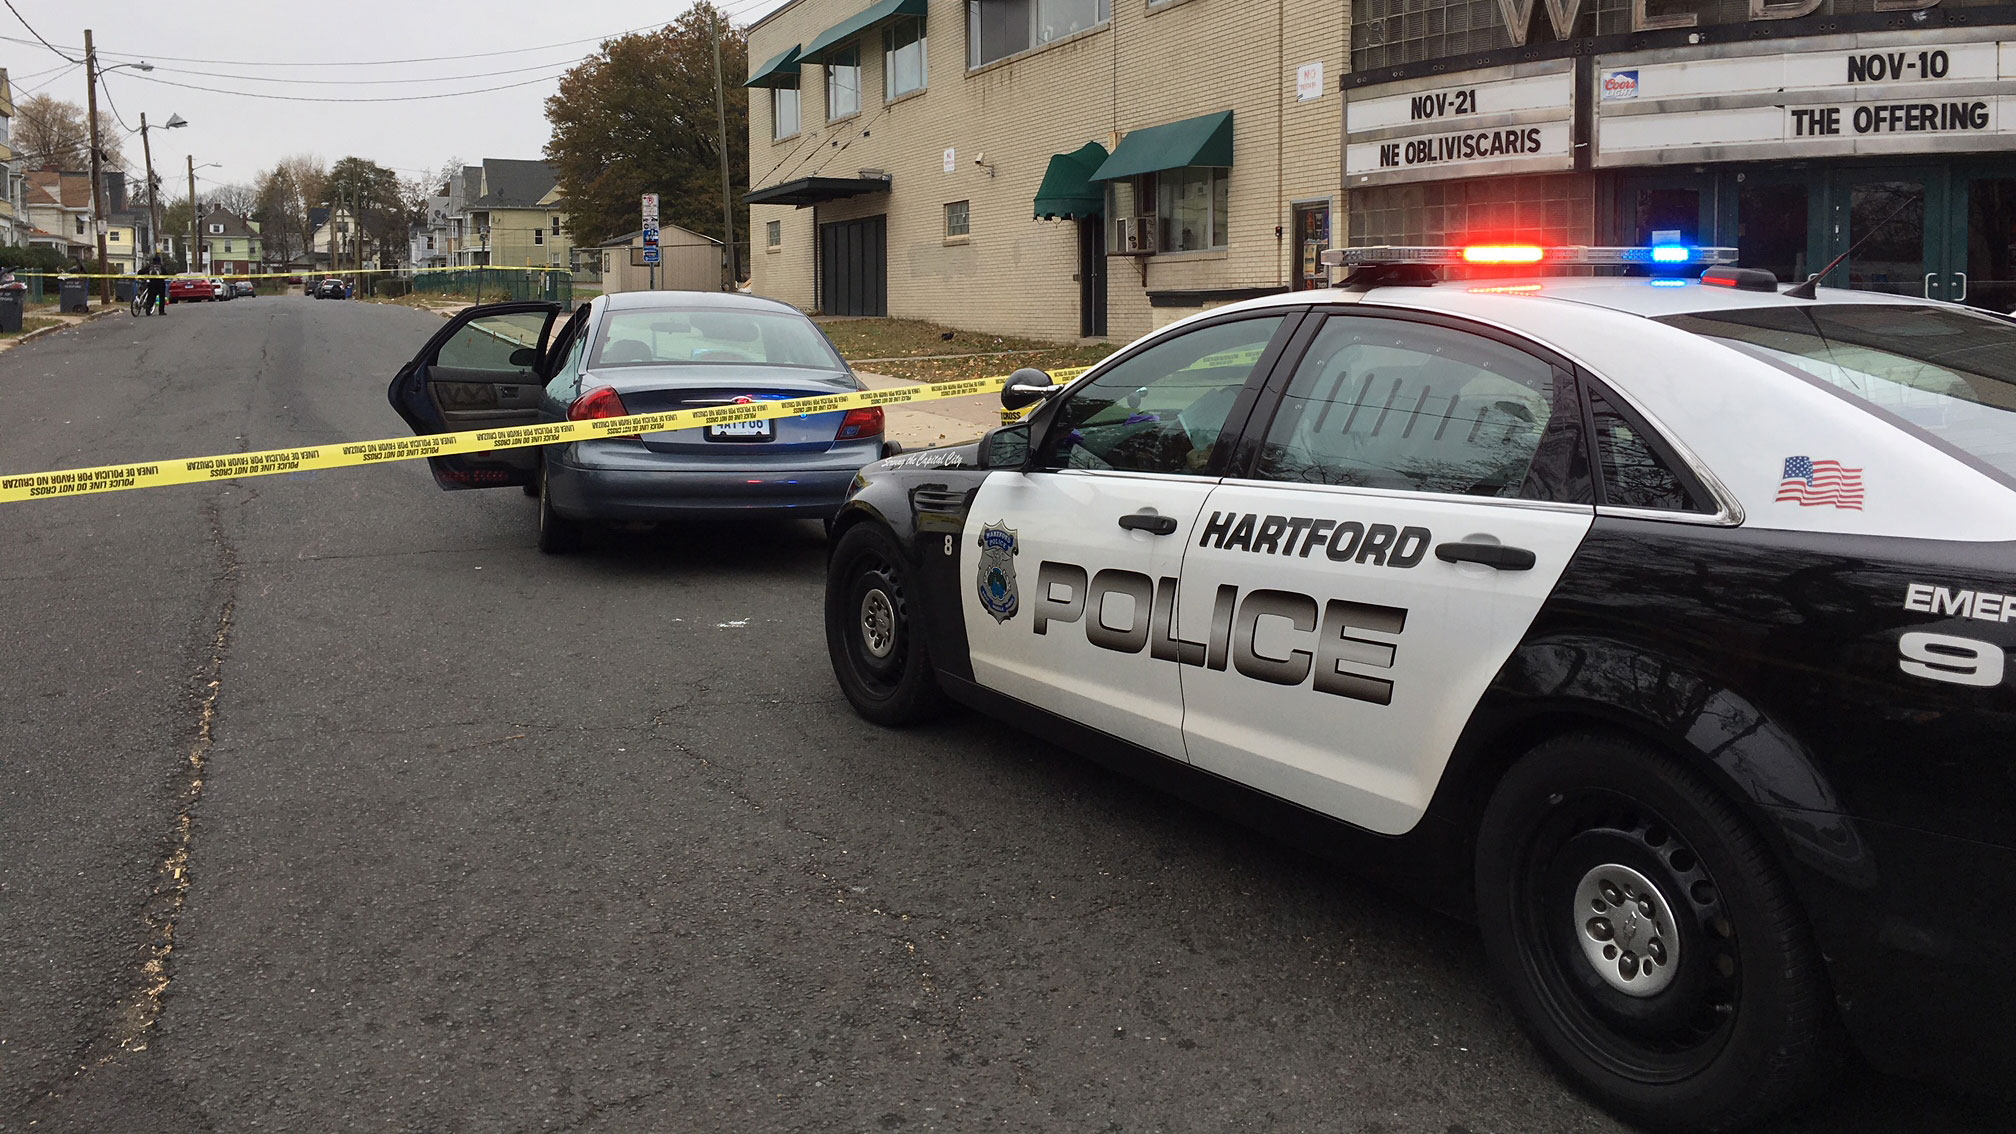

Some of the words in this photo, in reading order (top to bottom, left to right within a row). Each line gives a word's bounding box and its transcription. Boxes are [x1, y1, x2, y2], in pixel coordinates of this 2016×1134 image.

[1848, 50, 1948, 82] NOV-10
[1605, 79, 1635, 90] Coors
[1607, 89, 1634, 97] LIGHT
[1411, 90, 1476, 120] NOV-21
[1791, 108, 1840, 136] THE
[1853, 102, 1989, 134] OFFERING
[1380, 144, 1399, 167] NE
[1405, 128, 1541, 165] OBLIVISCARIS
[397, 441, 408, 449] POR
[409, 439, 431, 448] POLICIA
[432, 438, 439, 446] DE
[440, 436, 456, 445] LINEA
[343, 445, 366, 455] CRUZAR
[367, 444, 377, 452] NO
[378, 442, 396, 451] FAVOR
[420, 446, 439, 455] POLICE
[265, 453, 290, 463] POLICIA
[291, 452, 299, 460] DE
[300, 450, 319, 459] LINEA
[363, 453, 383, 461] CROSS
[384, 451, 396, 459] NOT
[216, 459, 226, 468] NO
[228, 457, 248, 466] FAVOR
[250, 455, 263, 464] POR
[906, 453, 917, 465] the
[916, 452, 947, 468] Capital
[945, 451, 963, 468] City
[186, 460, 214, 471] CRUZAR
[250, 465, 259, 473] DO
[260, 464, 276, 472] LINE
[277, 461, 299, 470] POLICE
[95, 469, 124, 480] POLICIA
[126, 468, 135, 477] DE
[137, 466, 159, 476] LINEA
[210, 468, 233, 477] CROSS
[37, 476, 49, 486] NO
[51, 473, 75, 485] FAVOR
[77, 472, 93, 482] POR
[2, 477, 35, 489] CRUZAR
[77, 483, 88, 491] DO
[90, 481, 107, 490] LINE
[109, 478, 135, 488] POLICE
[30, 486, 57, 496] CROSS
[58, 484, 75, 493] NOT
[989, 539, 1008, 549] POLICE
[1200, 511, 1432, 568] HARTFORD
[944, 534, 953, 556] 8
[1033, 560, 1409, 706] POLICE
[1899, 632, 2005, 687] 9
